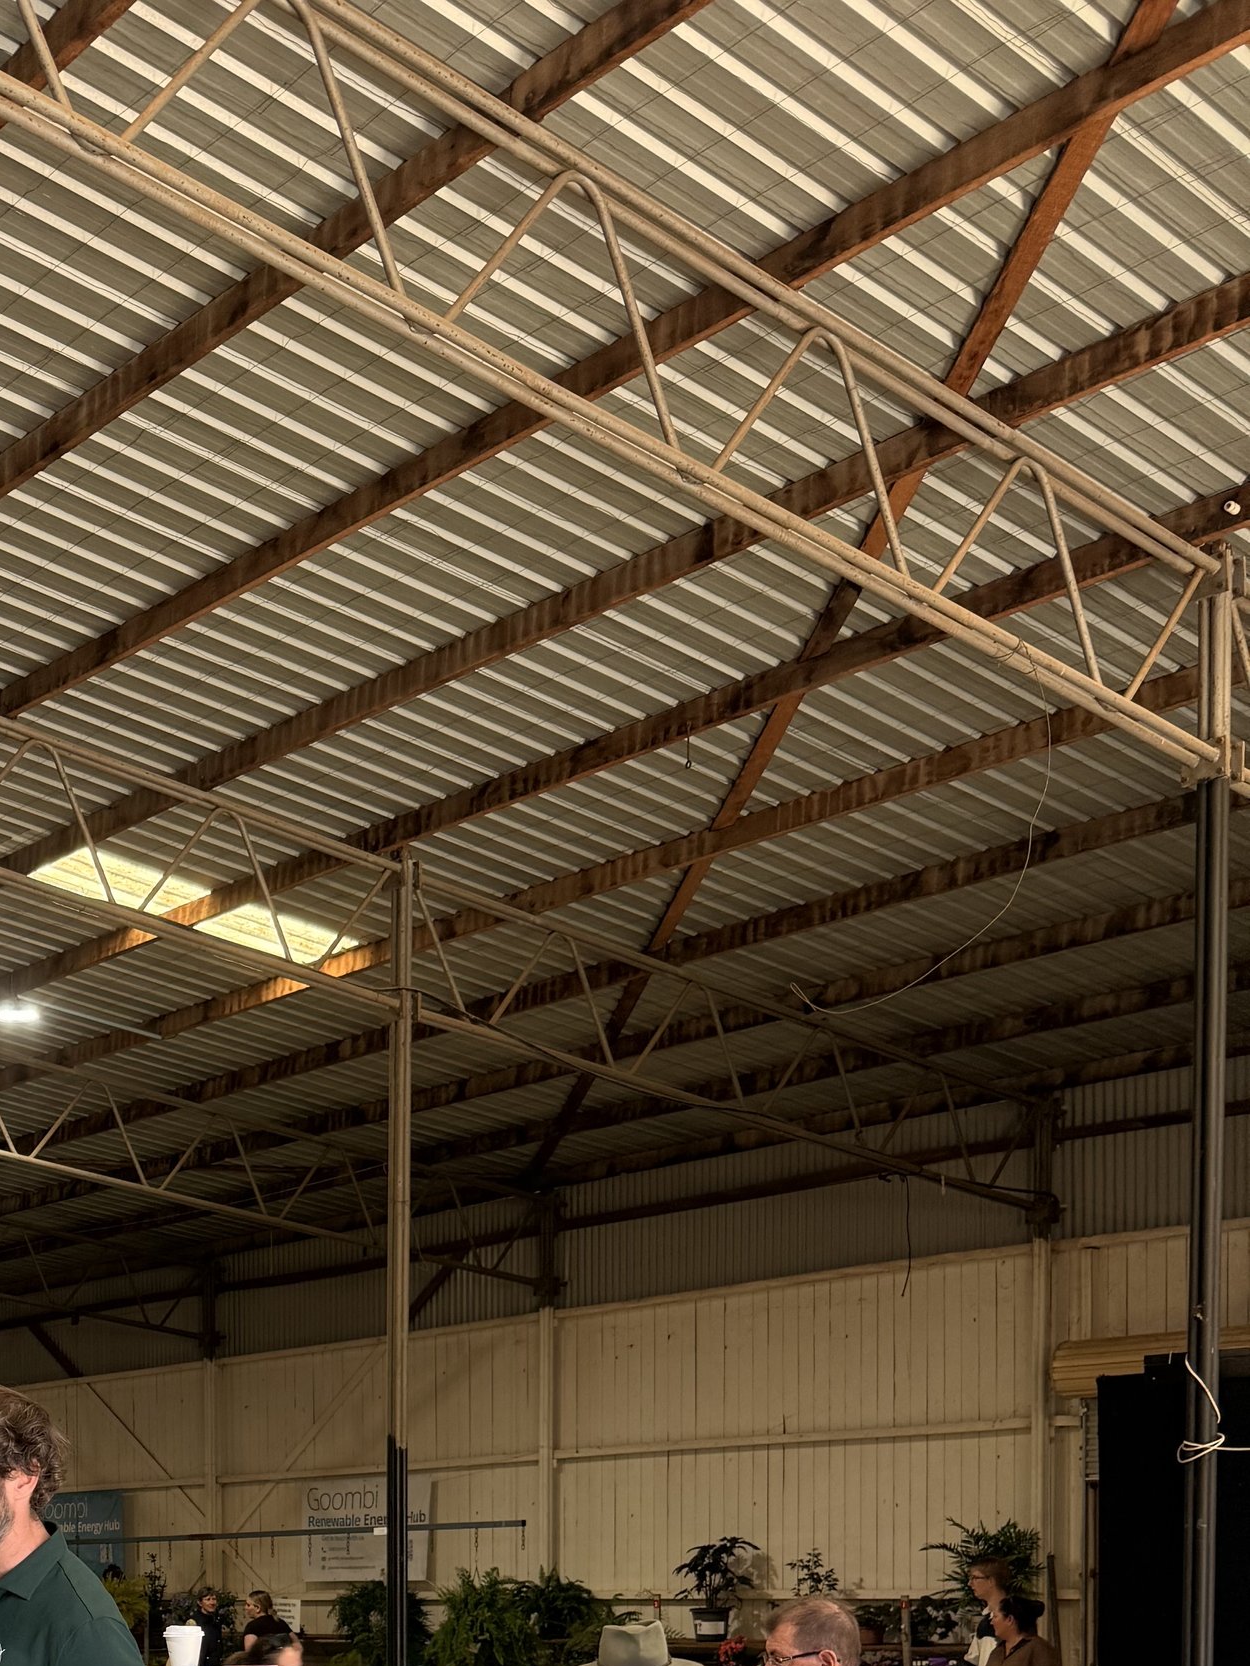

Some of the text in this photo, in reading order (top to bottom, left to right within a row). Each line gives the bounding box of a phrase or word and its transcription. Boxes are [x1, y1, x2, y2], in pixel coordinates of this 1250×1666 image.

[307, 1484, 379, 1512] Goombi
[44, 1498, 88, 1520] oombi
[78, 1521, 104, 1535] Energy
[104, 1519, 120, 1531] Hub
[308, 1514, 361, 1528] Renewable
[364, 1513, 388, 1526] Ener
